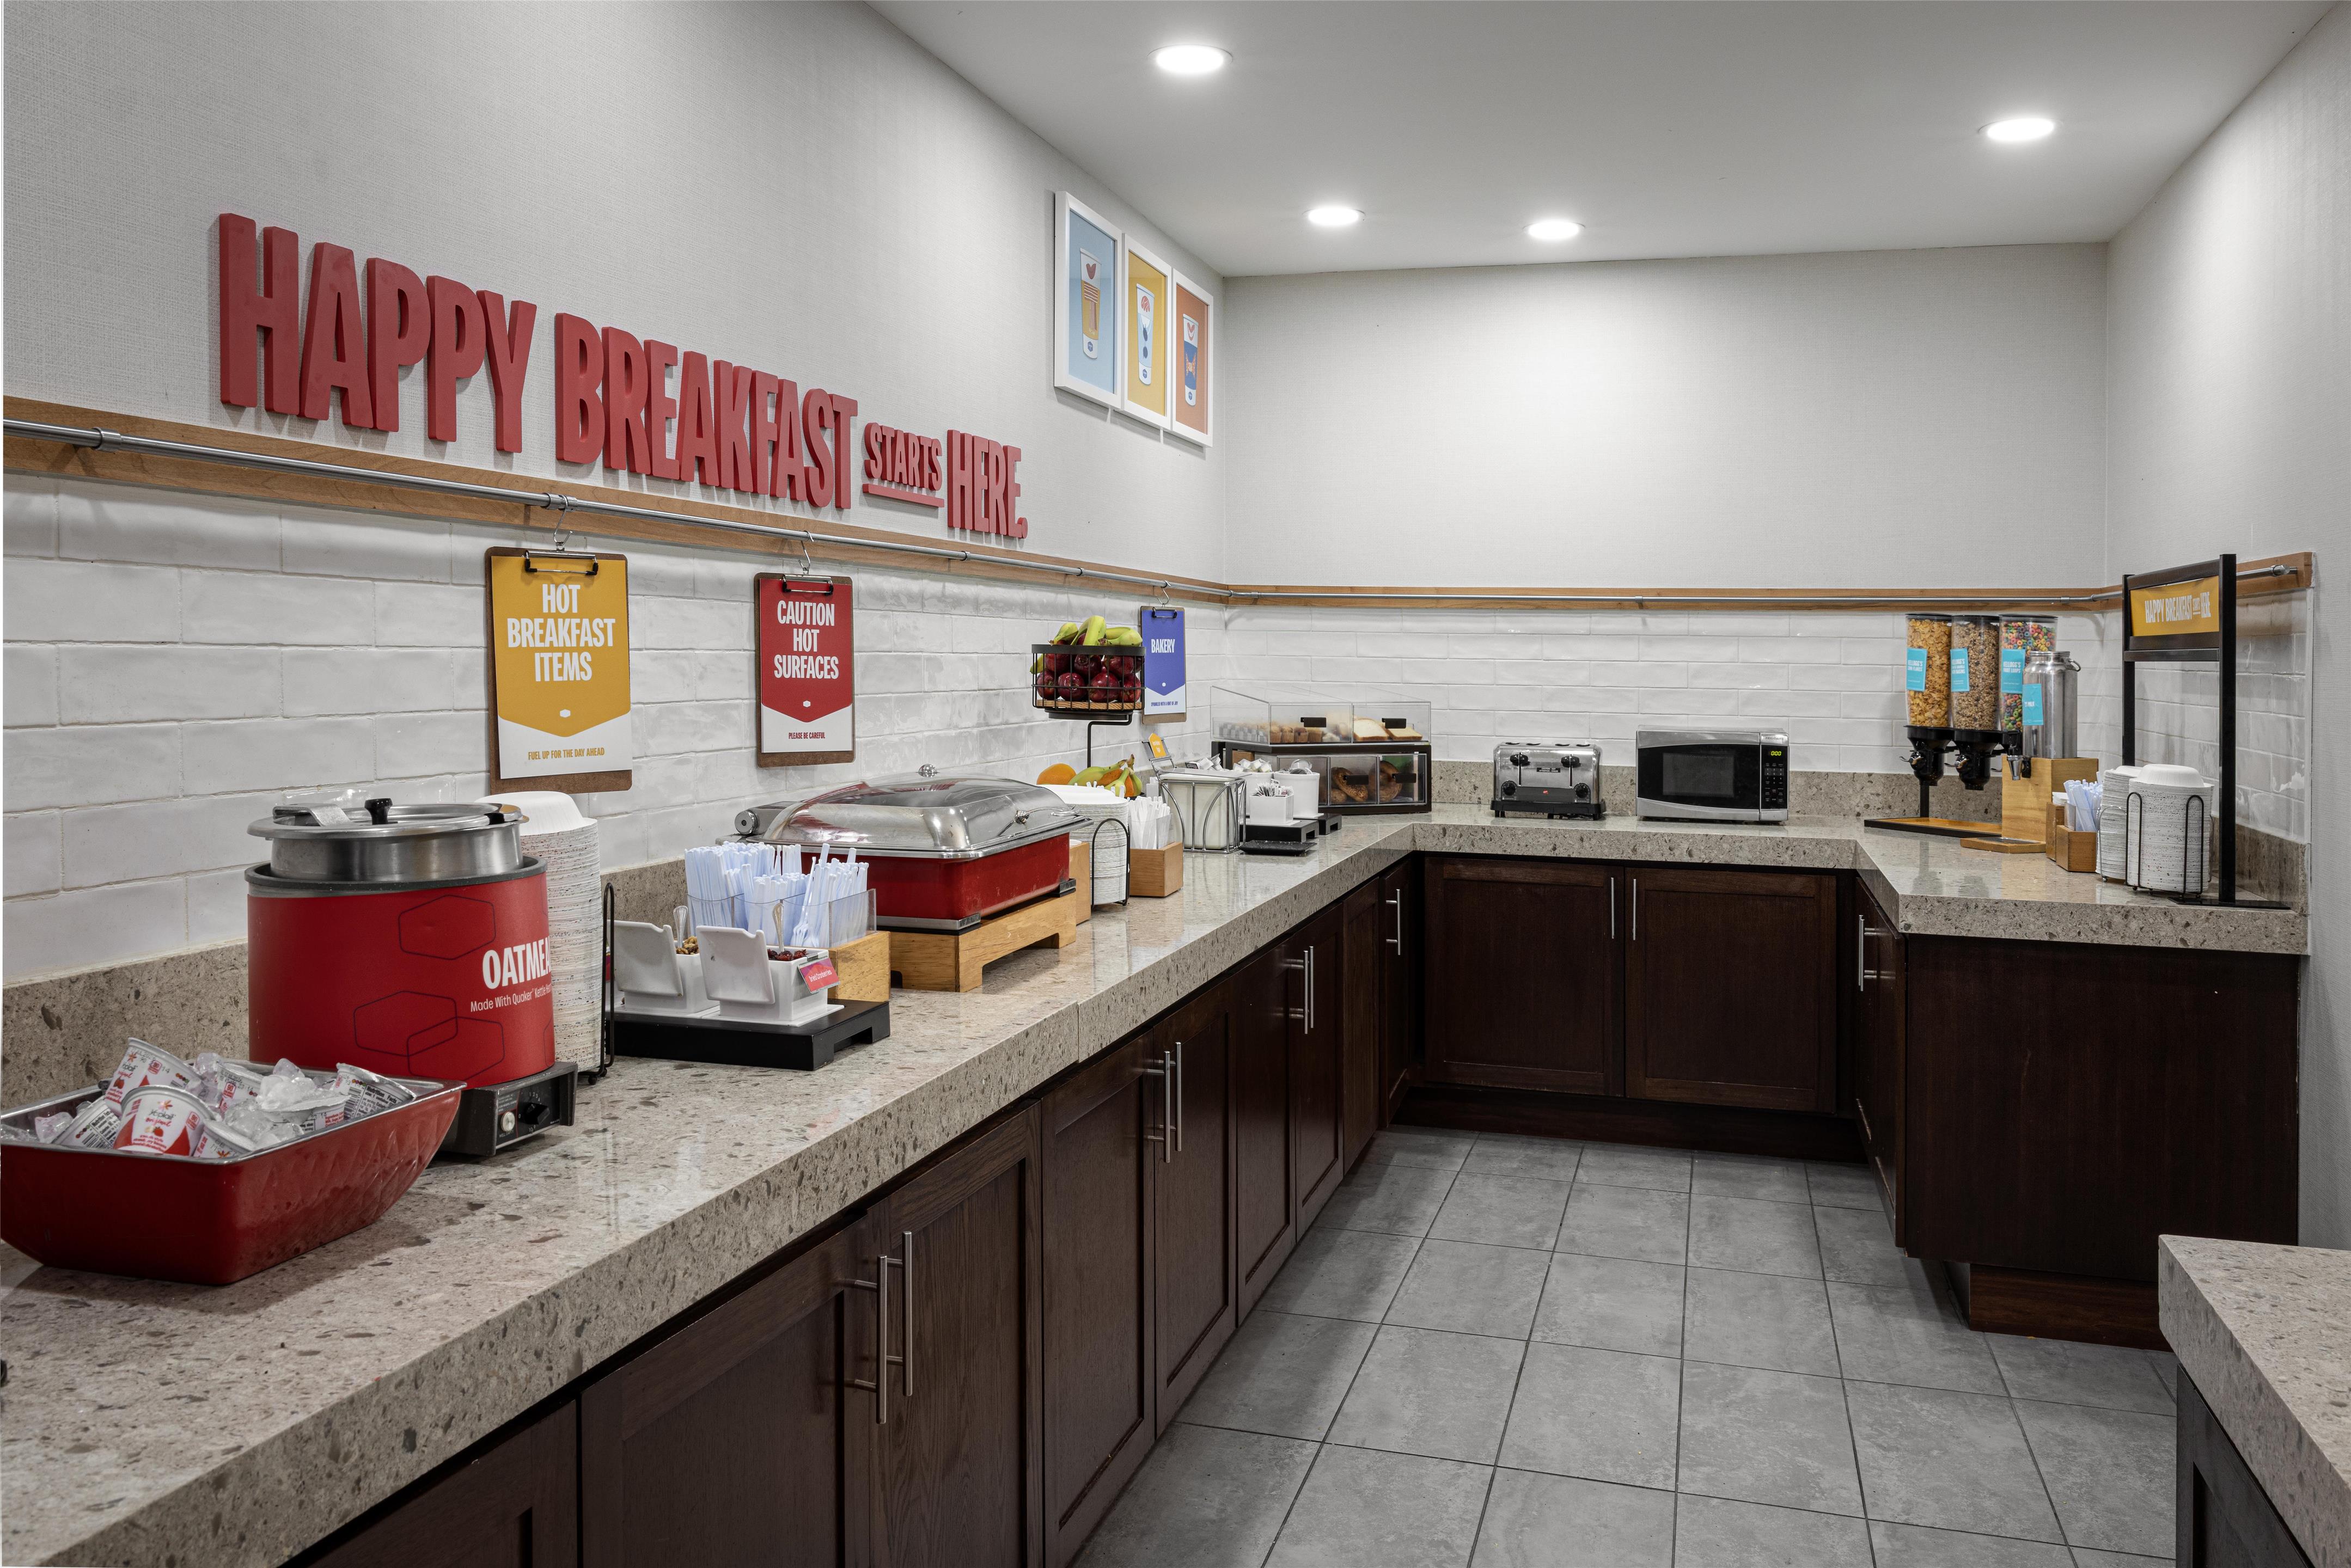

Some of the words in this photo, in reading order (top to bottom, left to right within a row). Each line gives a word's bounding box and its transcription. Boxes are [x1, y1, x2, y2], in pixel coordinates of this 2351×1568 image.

[219, 213, 537, 453] HAPPY
[555, 313, 858, 509] BREAKFAST
[864, 422, 943, 491] STARTS
[947, 429, 1028, 539] HERE.
[542, 584, 581, 614] HOT
[2145, 598, 2164, 623] HAPPY
[2165, 595, 2192, 622] BREAKFAST
[777, 600, 835, 626] CAUTION
[507, 618, 615, 648] BREAKFAST
[793, 628, 820, 652] HOT
[1151, 639, 1175, 653] BAKERY
[534, 652, 593, 682] ITEMS
[774, 654, 839, 679] SURFACES
[528, 751, 541, 760] FUEL
[542, 750, 549, 759] UP
[551, 750, 561, 759] FOR
[563, 749, 573, 758] THE
[575, 748, 585, 757] DAY
[586, 747, 605, 757] AHEAD
[808, 973, 817, 982] Dried
[471, 999, 493, 1012] Made
[495, 994, 511, 1008] With
[534, 985, 546, 999] Kettle
[367, 1086, 385, 1098] Nutrition
[387, 1095, 397, 1104] Facts
